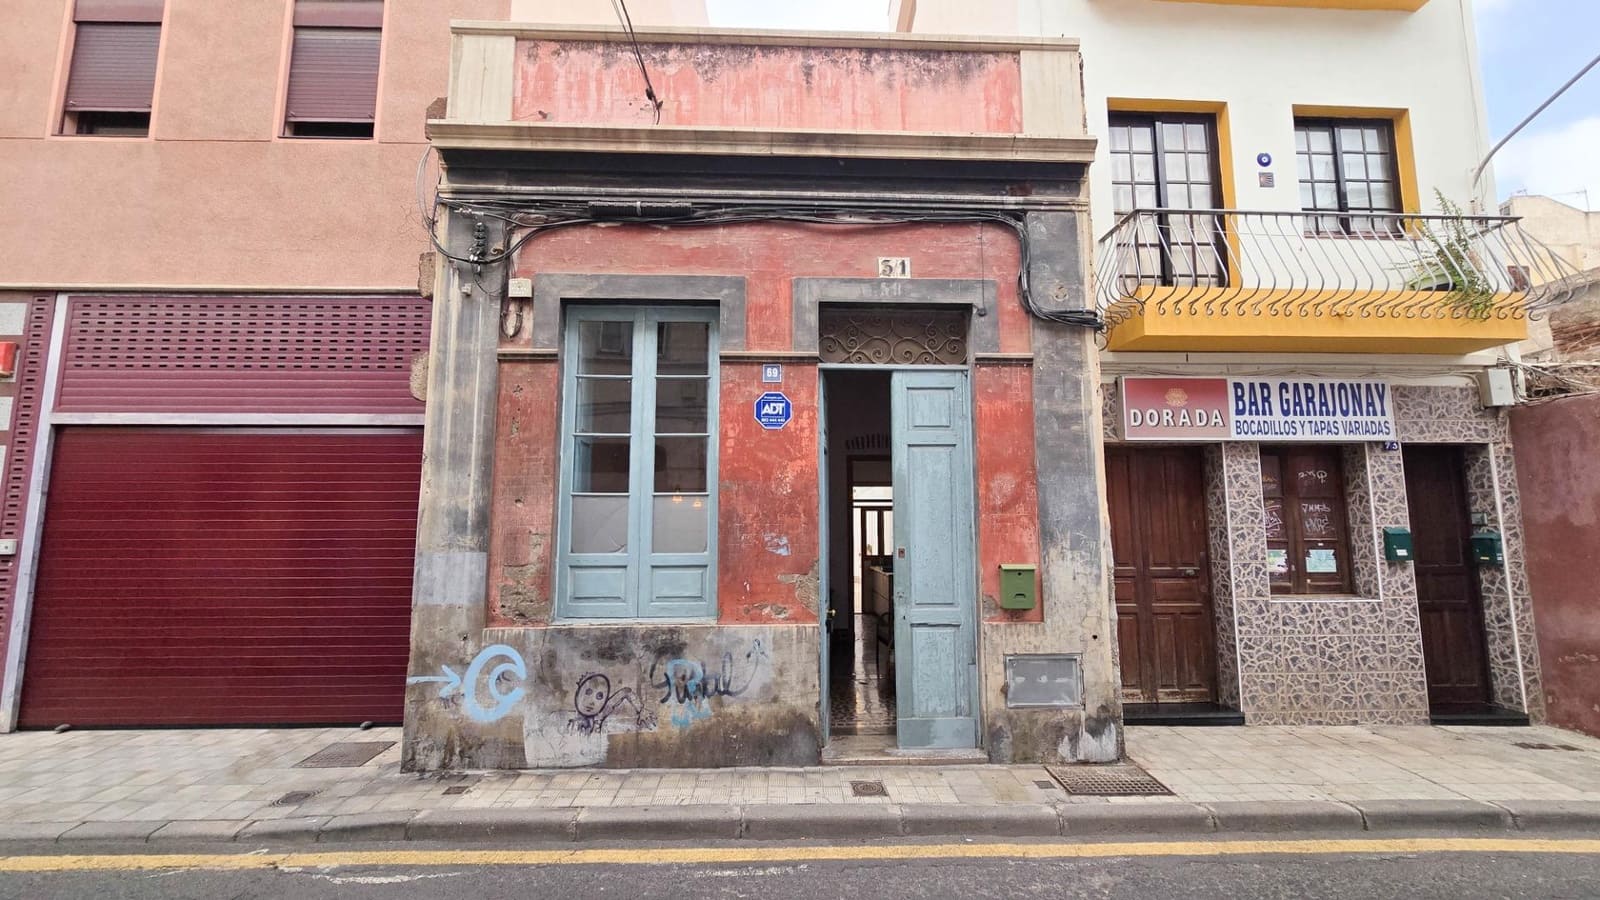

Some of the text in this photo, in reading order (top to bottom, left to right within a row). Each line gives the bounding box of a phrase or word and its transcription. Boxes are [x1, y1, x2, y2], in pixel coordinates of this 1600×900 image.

[761, 402, 785, 415] ADT
[1233, 382, 1386, 417] BAR GARAJONAY
[1130, 407, 1225, 428] DORADA
[1235, 420, 1391, 436] BOCADILLOS Y TAPAS VARIADAS
